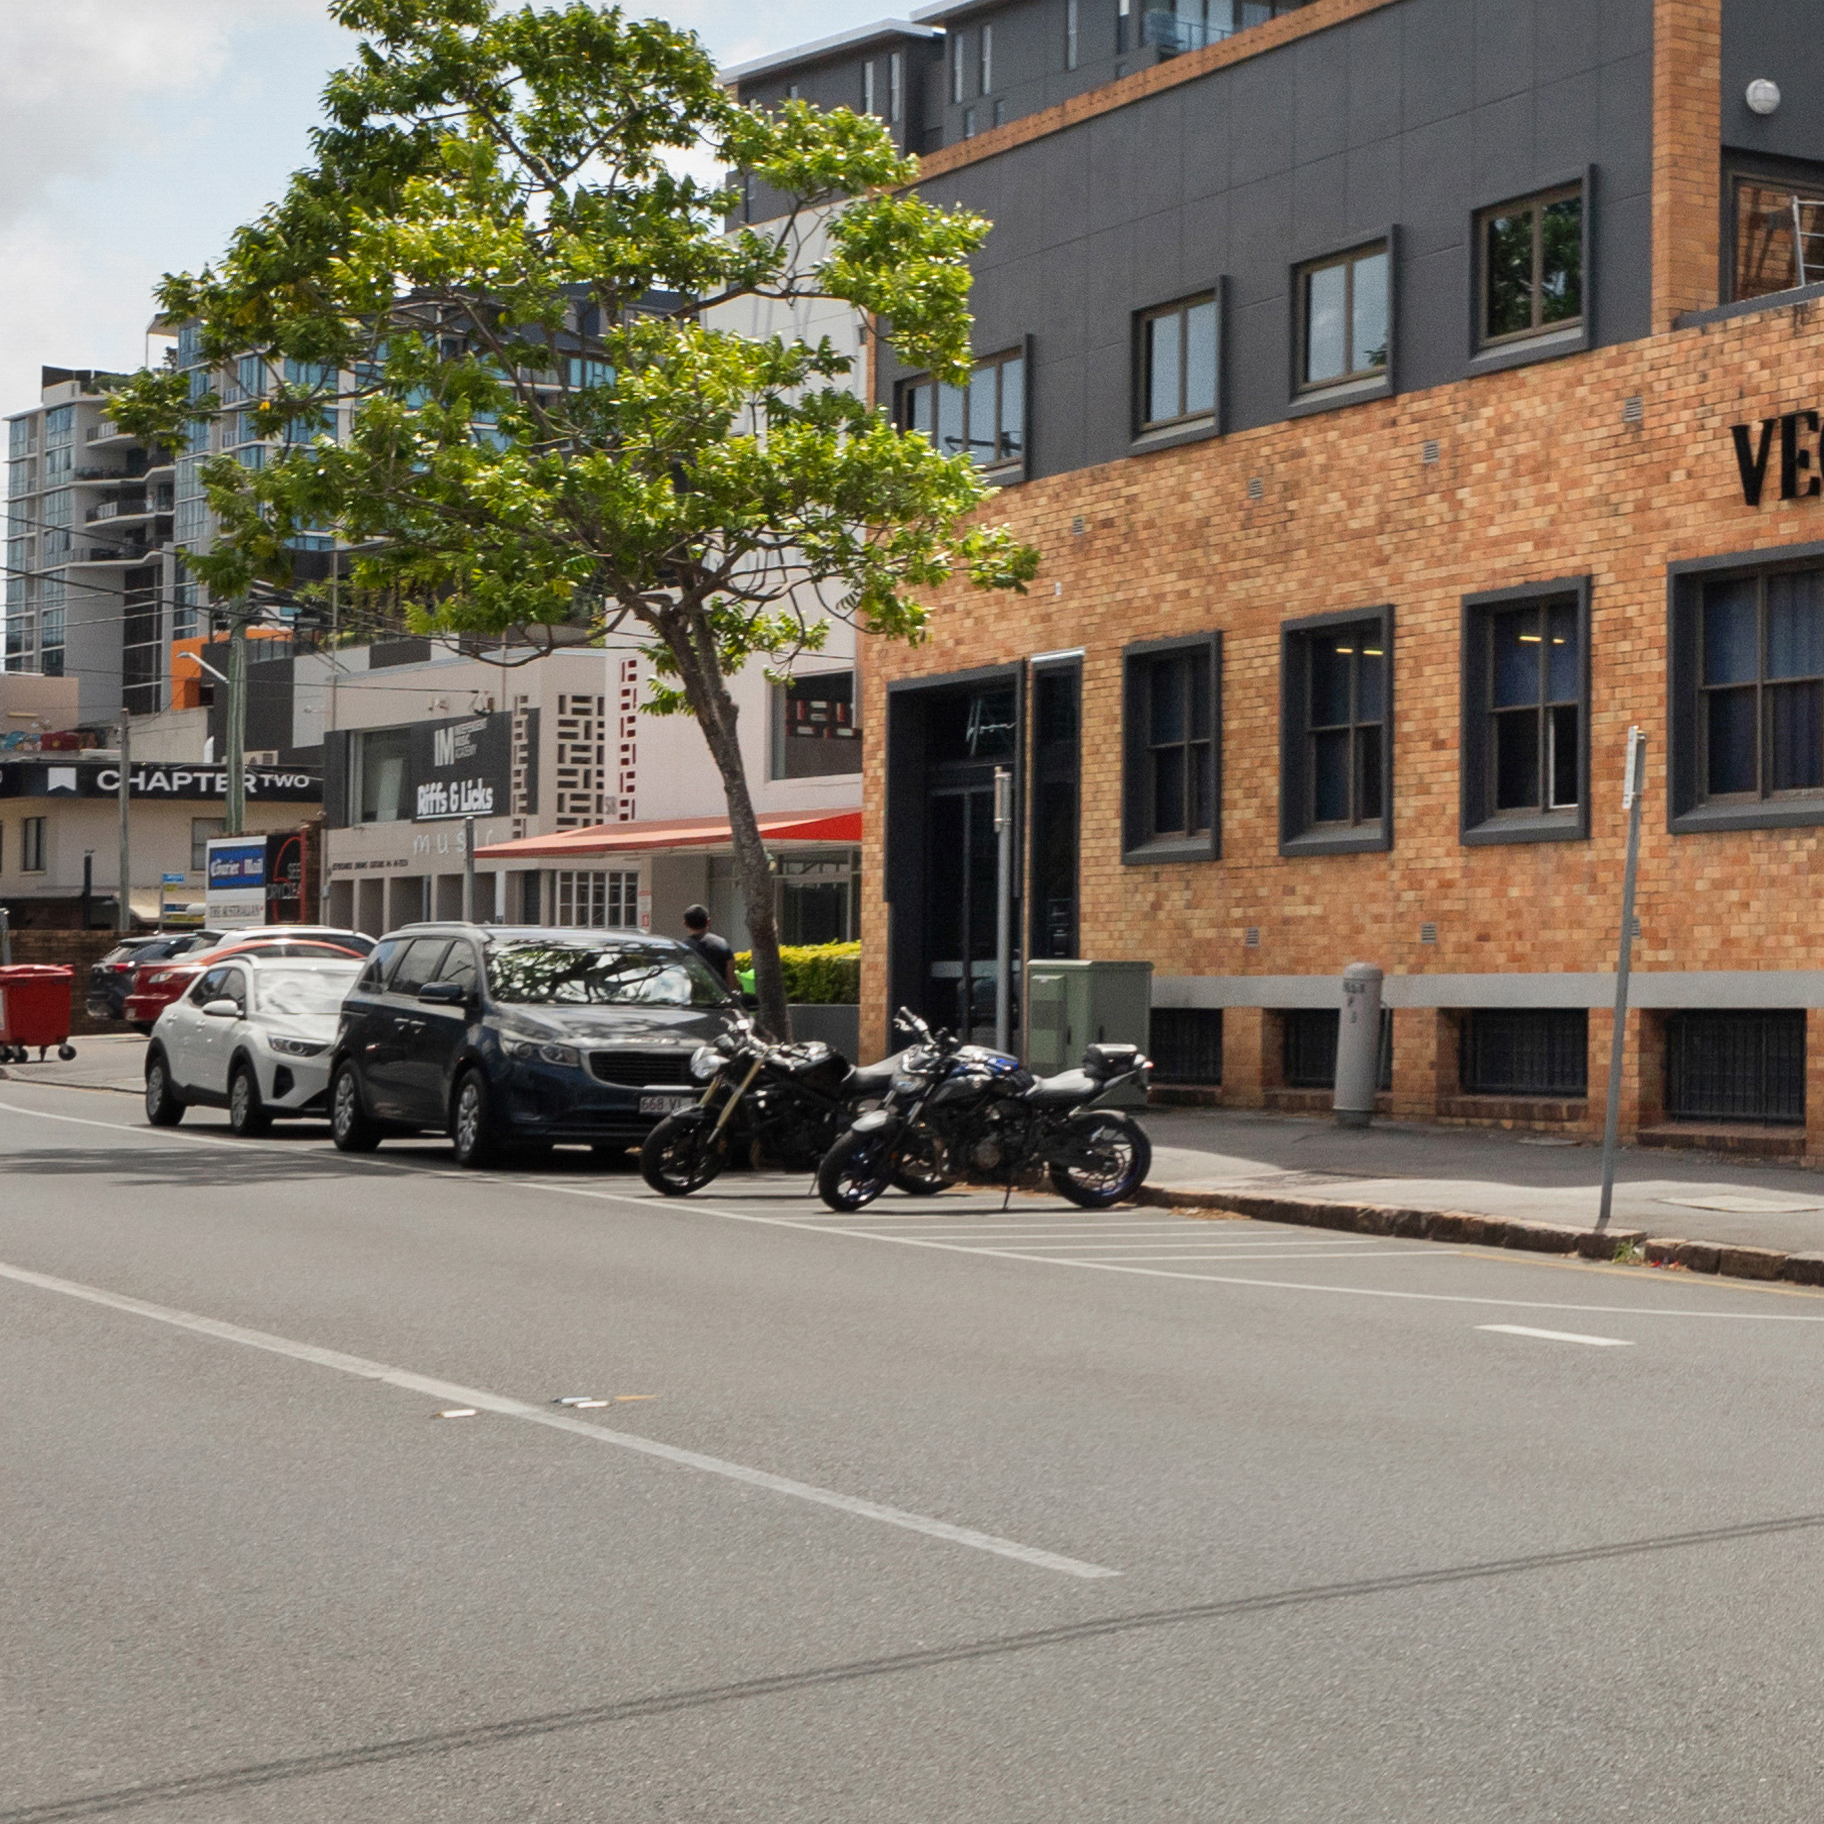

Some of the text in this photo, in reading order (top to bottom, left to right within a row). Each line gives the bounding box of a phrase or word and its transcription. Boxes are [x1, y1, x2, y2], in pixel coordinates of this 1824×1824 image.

[434, 725, 455, 767] IM
[97, 769, 310, 793] CHAPTER TWO
[417, 777, 494, 815] Riffs & Licks
[244, 858, 264, 875] Mail
